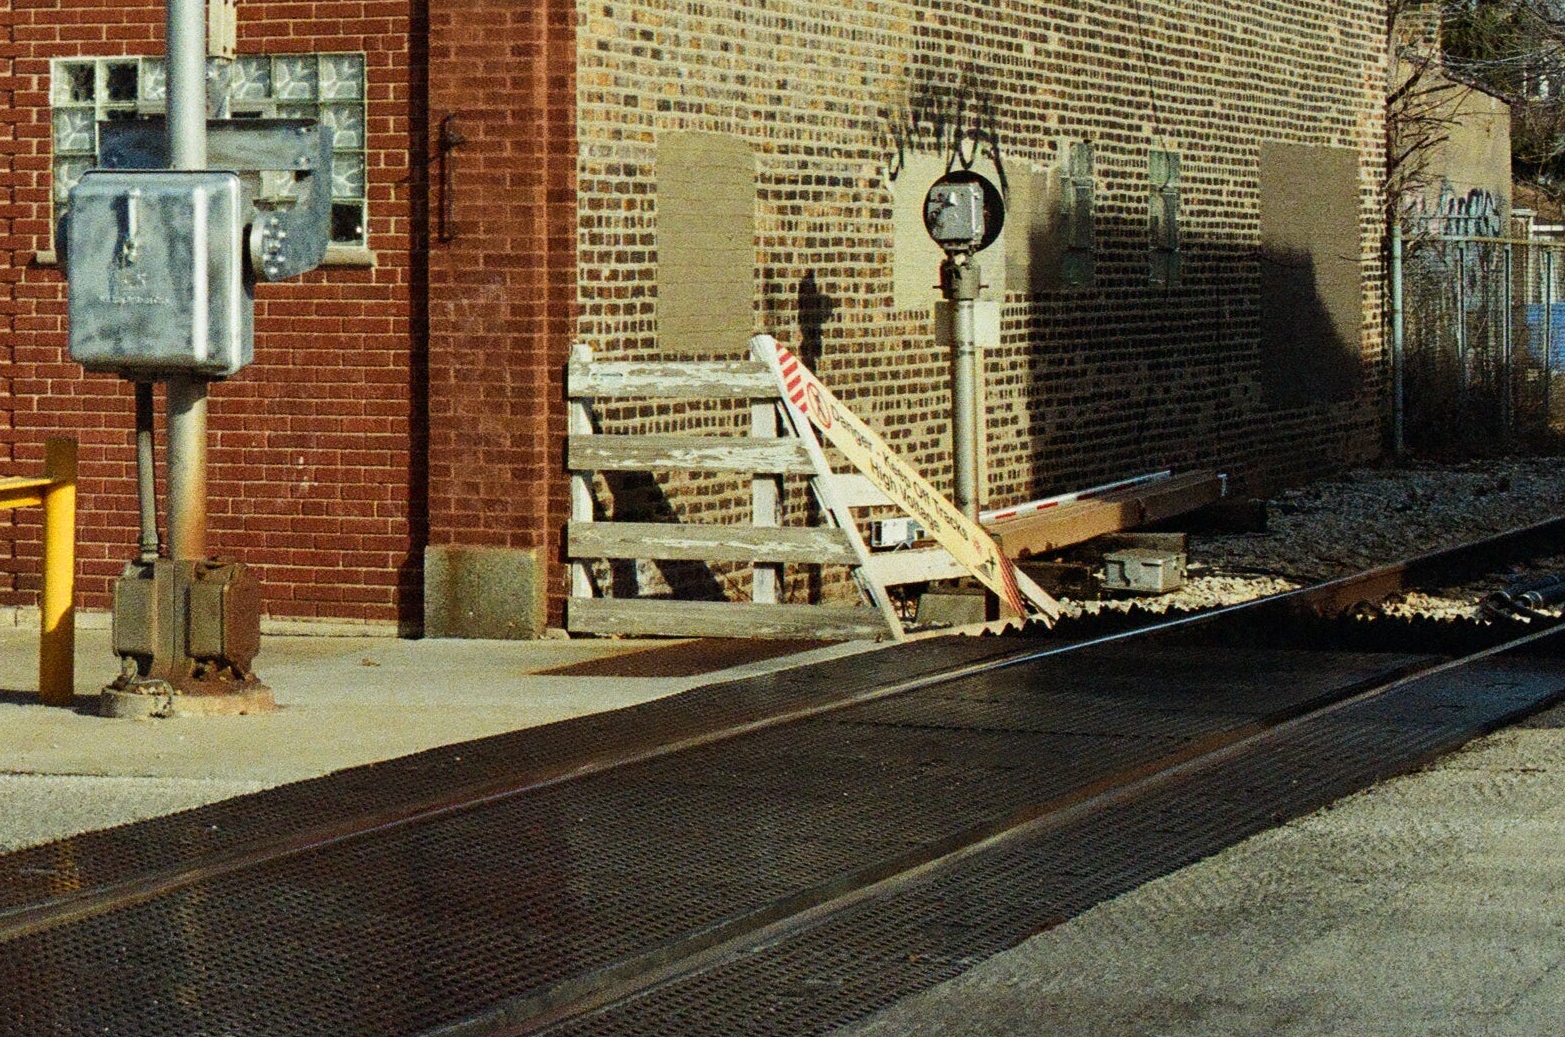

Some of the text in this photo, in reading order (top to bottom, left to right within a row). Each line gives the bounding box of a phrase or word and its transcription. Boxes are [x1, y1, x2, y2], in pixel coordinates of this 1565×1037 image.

[831, 404, 872, 452] Danger
[882, 451, 911, 489] Keep
[931, 497, 968, 541] Tracks
[870, 457, 940, 533] High Voltage
